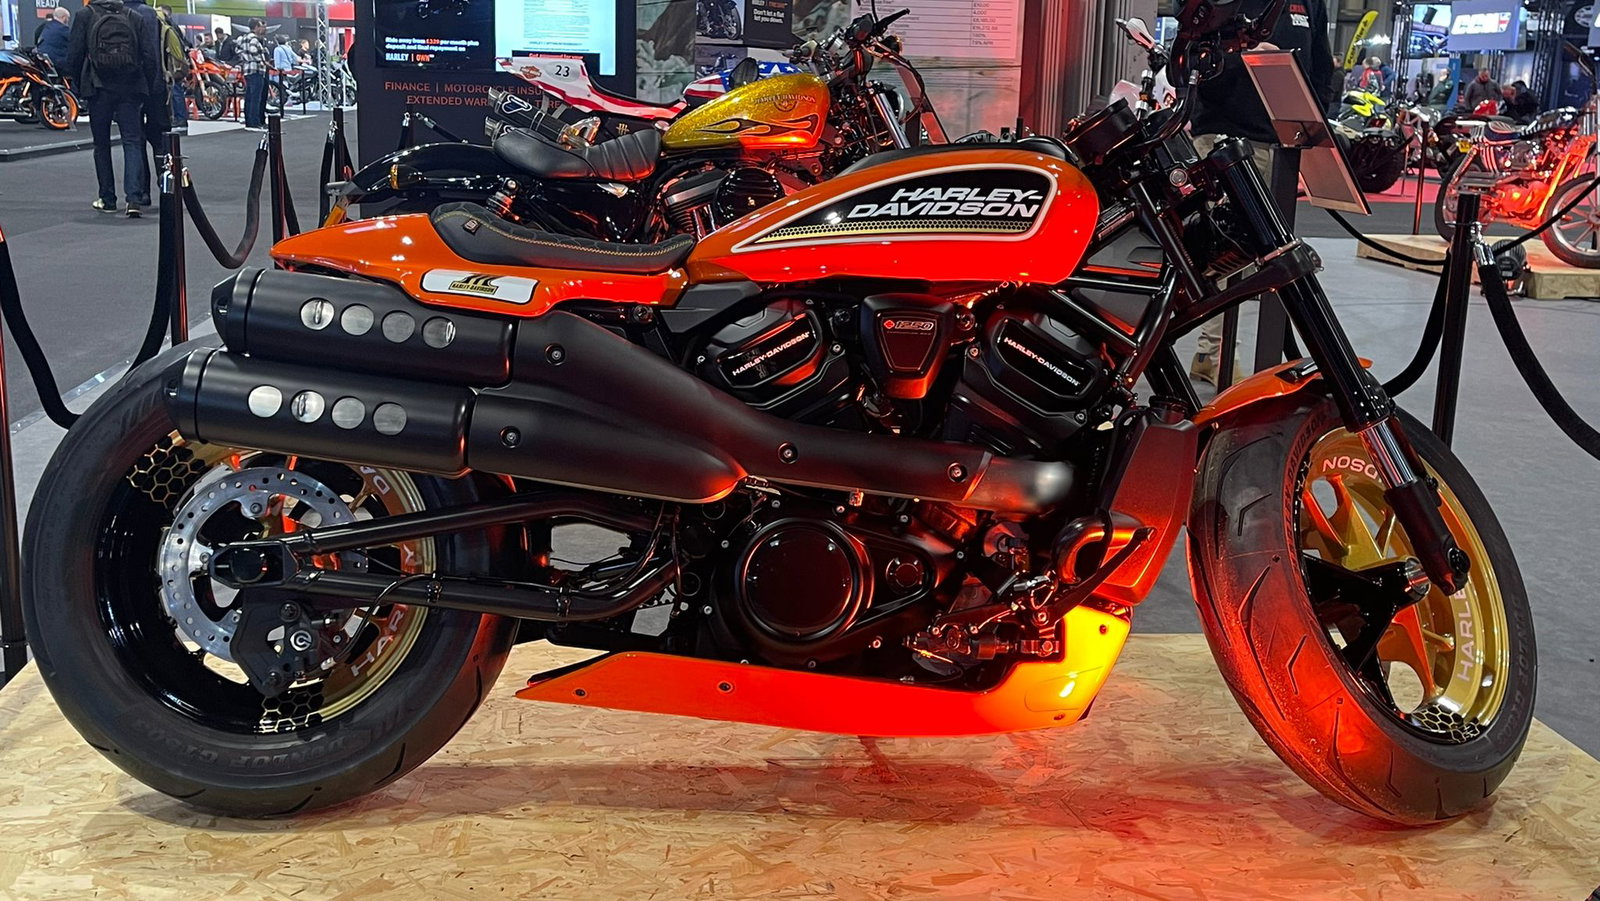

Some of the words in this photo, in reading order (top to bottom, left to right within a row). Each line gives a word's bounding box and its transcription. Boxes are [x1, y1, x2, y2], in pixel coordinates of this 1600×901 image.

[555, 65, 570, 77] 23
[385, 82, 430, 91] FINANCE
[407, 96, 462, 105] EXTENDED
[890, 187, 1043, 202] HARLEY-
[847, 202, 1040, 218] DAVIDSON
[732, 331, 809, 376] HARLEY-DAVIDSON
[1004, 337, 1080, 386] HARLEY-DAVIDSON
[1322, 455, 1379, 480] DSON
[1454, 588, 1475, 682] HARLE
